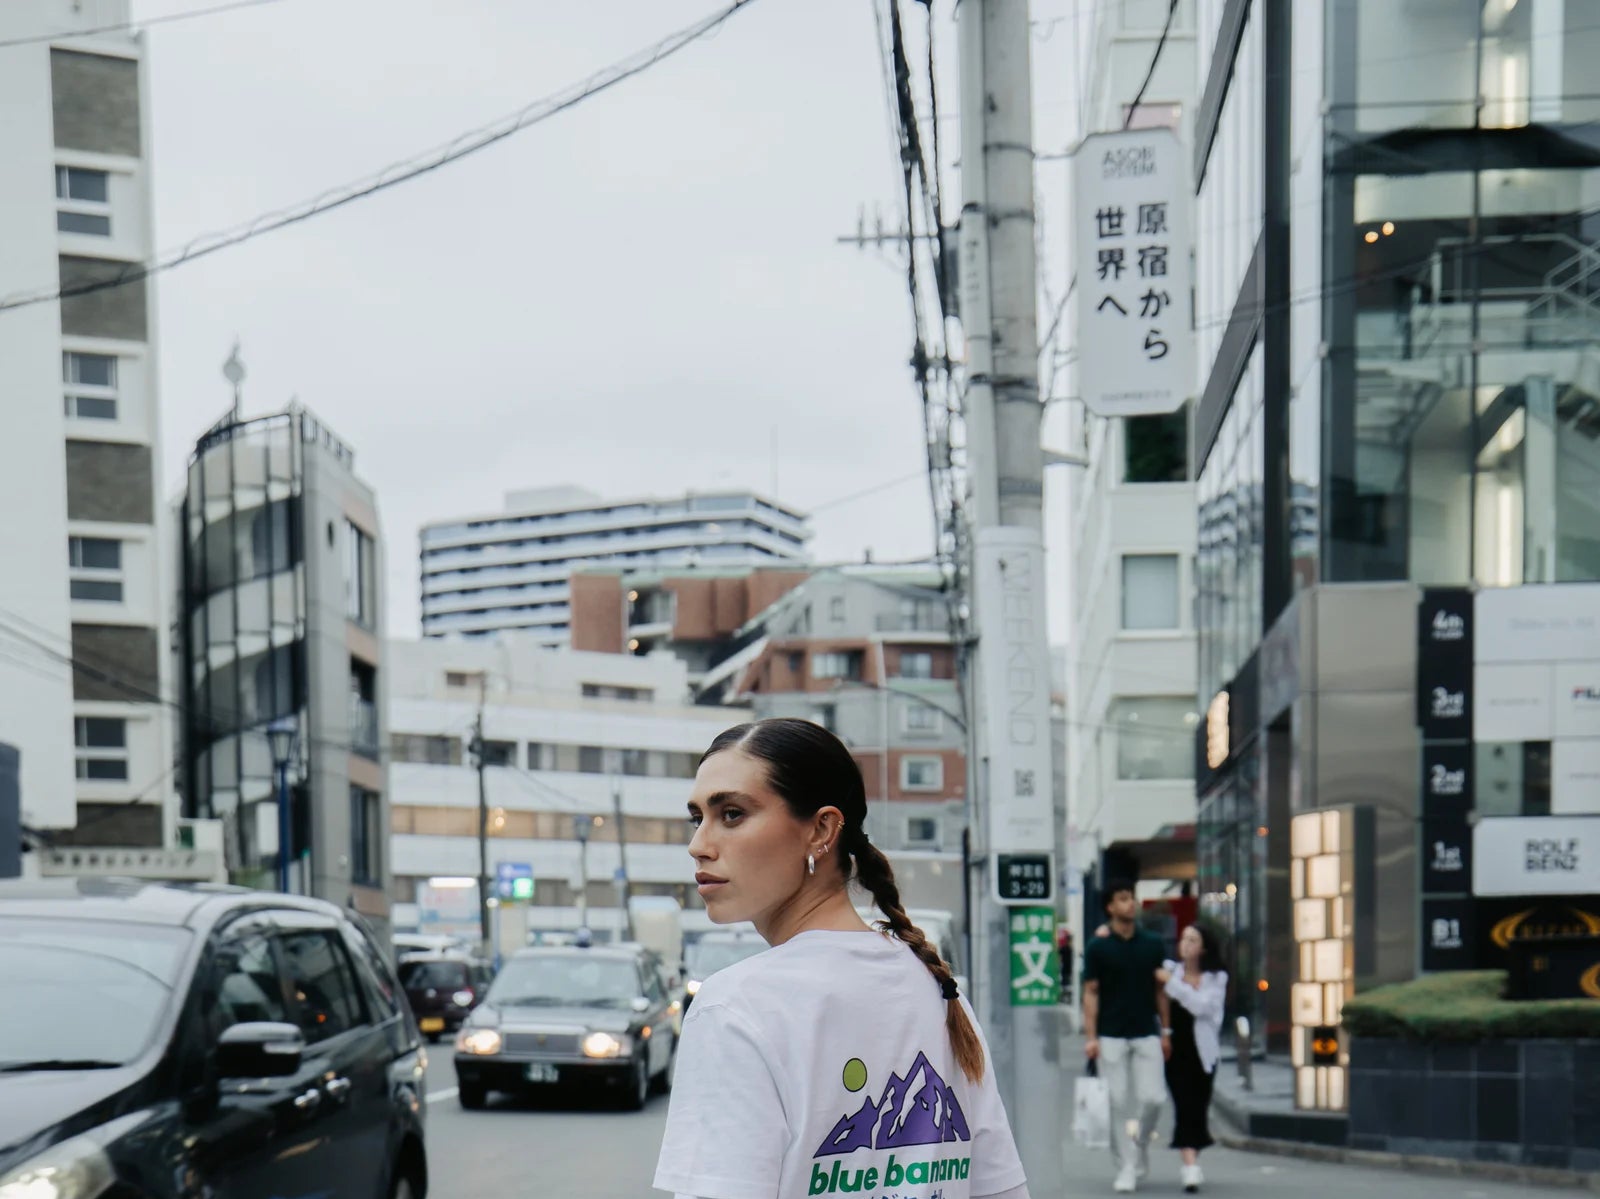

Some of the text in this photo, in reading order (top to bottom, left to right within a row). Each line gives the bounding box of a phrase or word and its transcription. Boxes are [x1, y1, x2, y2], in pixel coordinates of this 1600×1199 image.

[1095, 206, 1128, 317] 世界へ
[1136, 203, 1170, 360] 原宿から
[1001, 551, 1039, 747] WEEKEND
[1573, 687, 1600, 700] FIL
[1525, 854, 1579, 871] BENZ
[1526, 839, 1580, 855] ROLF
[1012, 935, 1054, 989] 文
[808, 1154, 971, 1196] blue banana
